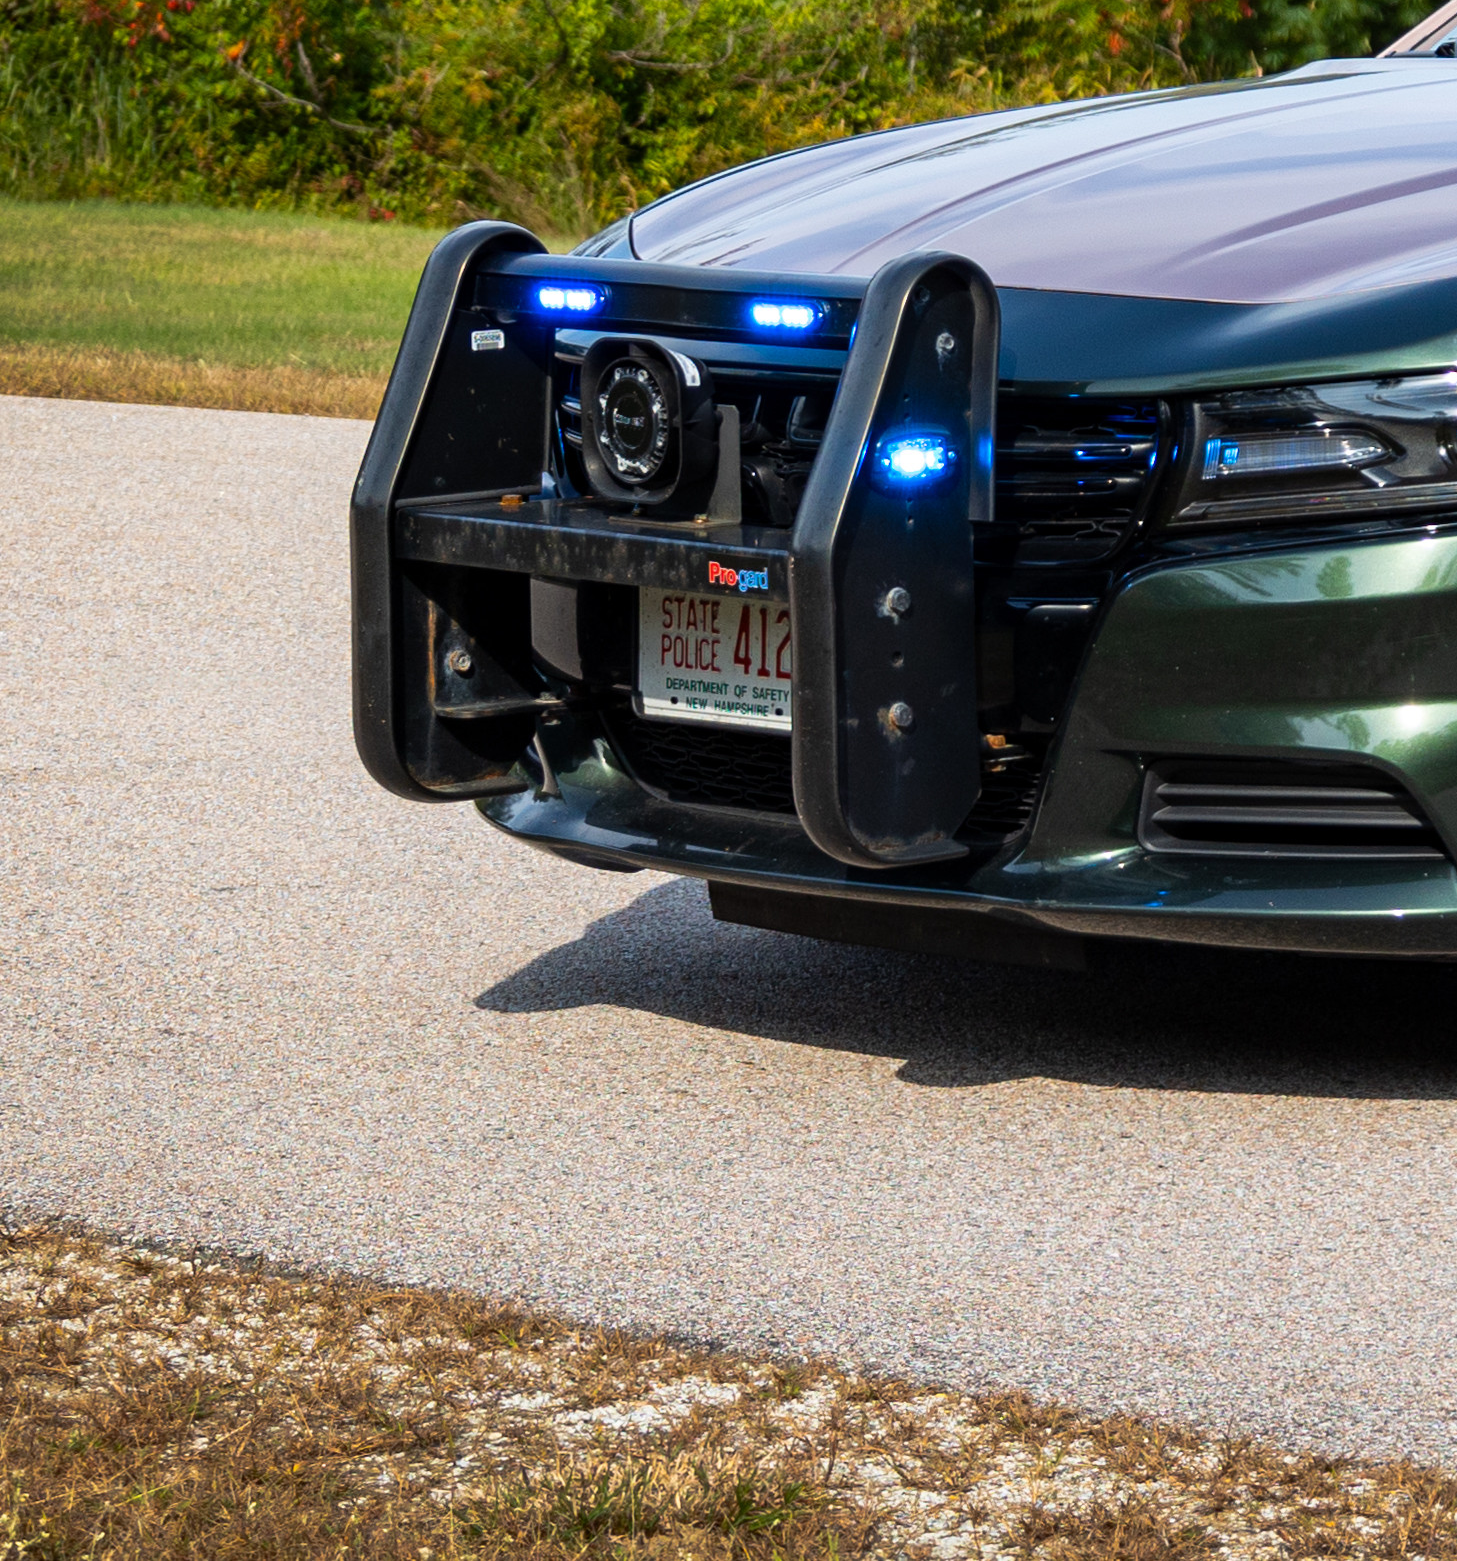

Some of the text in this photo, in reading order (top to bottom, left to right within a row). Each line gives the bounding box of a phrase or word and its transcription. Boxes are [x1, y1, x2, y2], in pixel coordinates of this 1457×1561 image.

[661, 595, 721, 635] STATE
[661, 634, 721, 673] POLICE
[733, 603, 792, 680] 412
[665, 676, 790, 703] DEPARTMENT OF SAFETY
[685, 696, 769, 717] NEW HAMPSHIRE
